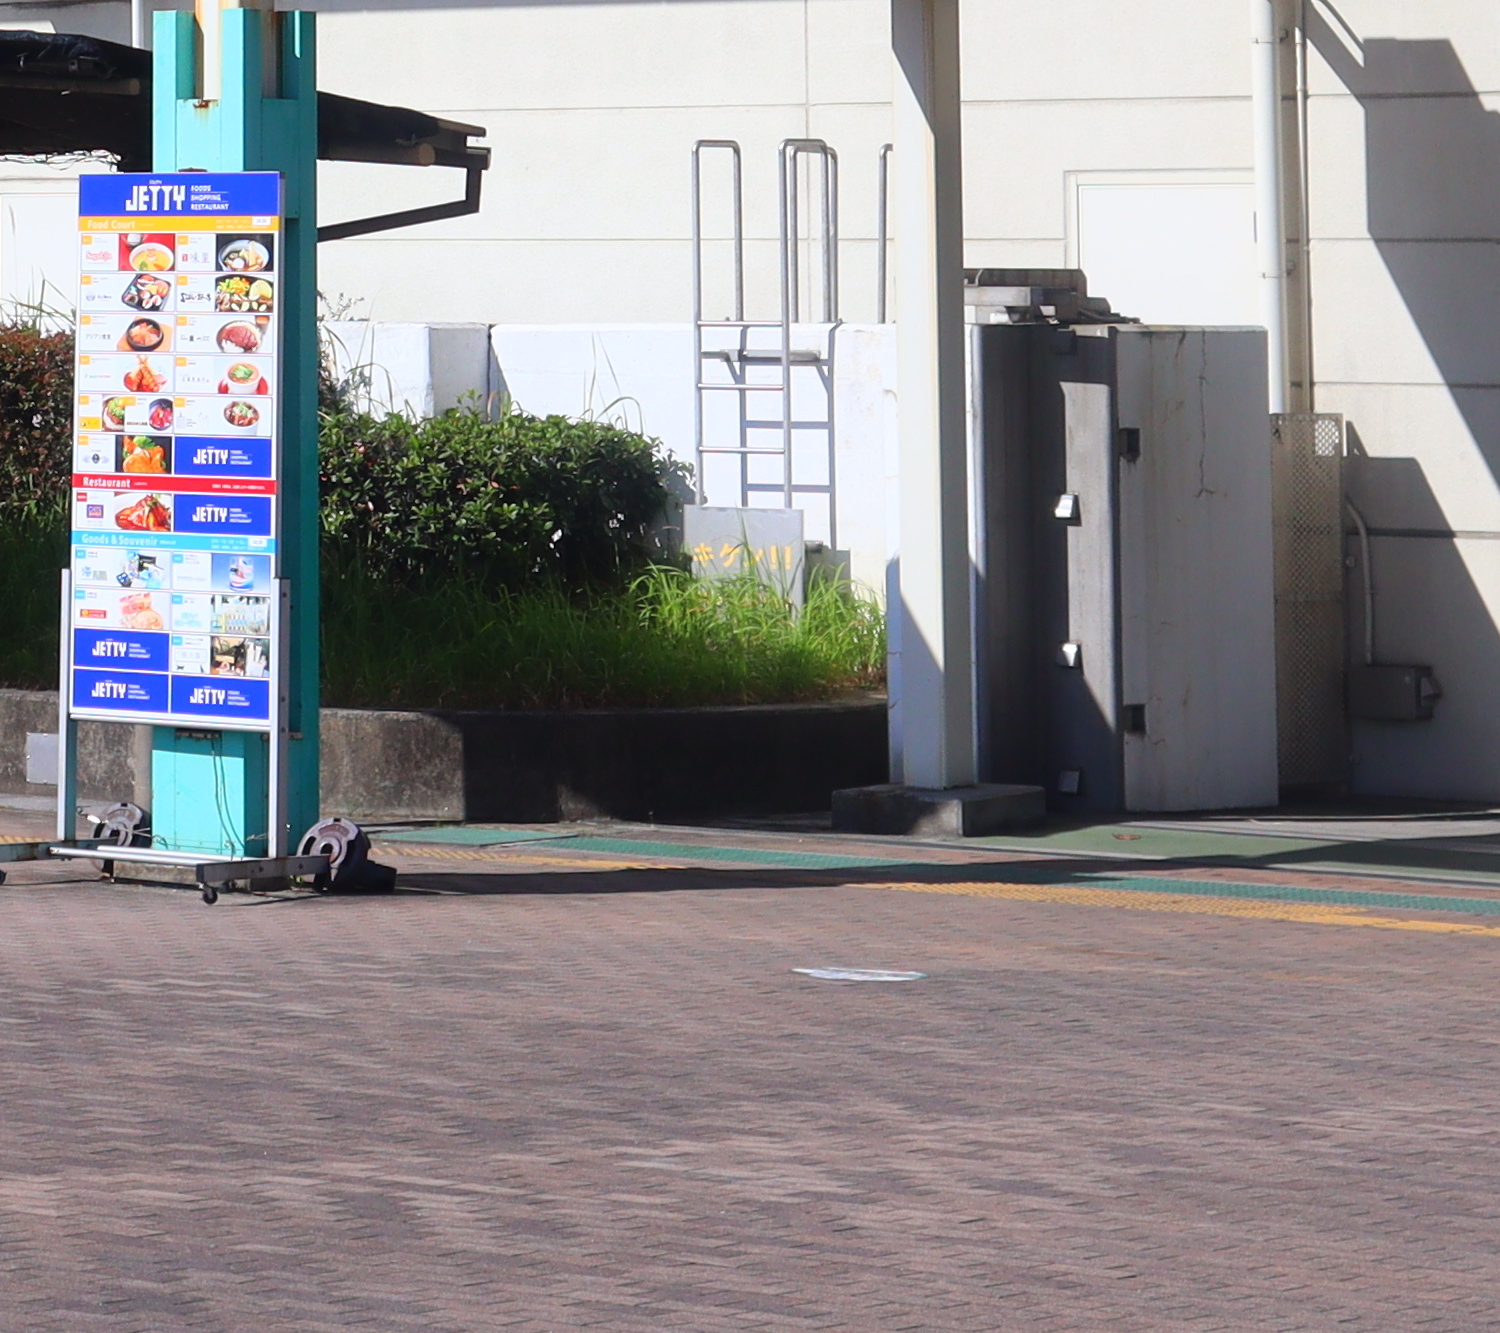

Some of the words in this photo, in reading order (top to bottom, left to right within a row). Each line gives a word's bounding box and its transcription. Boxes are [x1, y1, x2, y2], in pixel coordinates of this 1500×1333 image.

[125, 185, 186, 211] JETTY
[87, 220, 109, 229] Food
[111, 220, 136, 229] Court
[193, 448, 229, 465] JETTY
[82, 477, 131, 488] Restaurant
[192, 506, 228, 523] JETTY
[81, 533, 109, 544] Goods
[118, 535, 158, 546] Souvenir
[92, 640, 127, 657] JETTY
[91, 681, 127, 699] JETTY
[189, 687, 226, 705] JETTY
